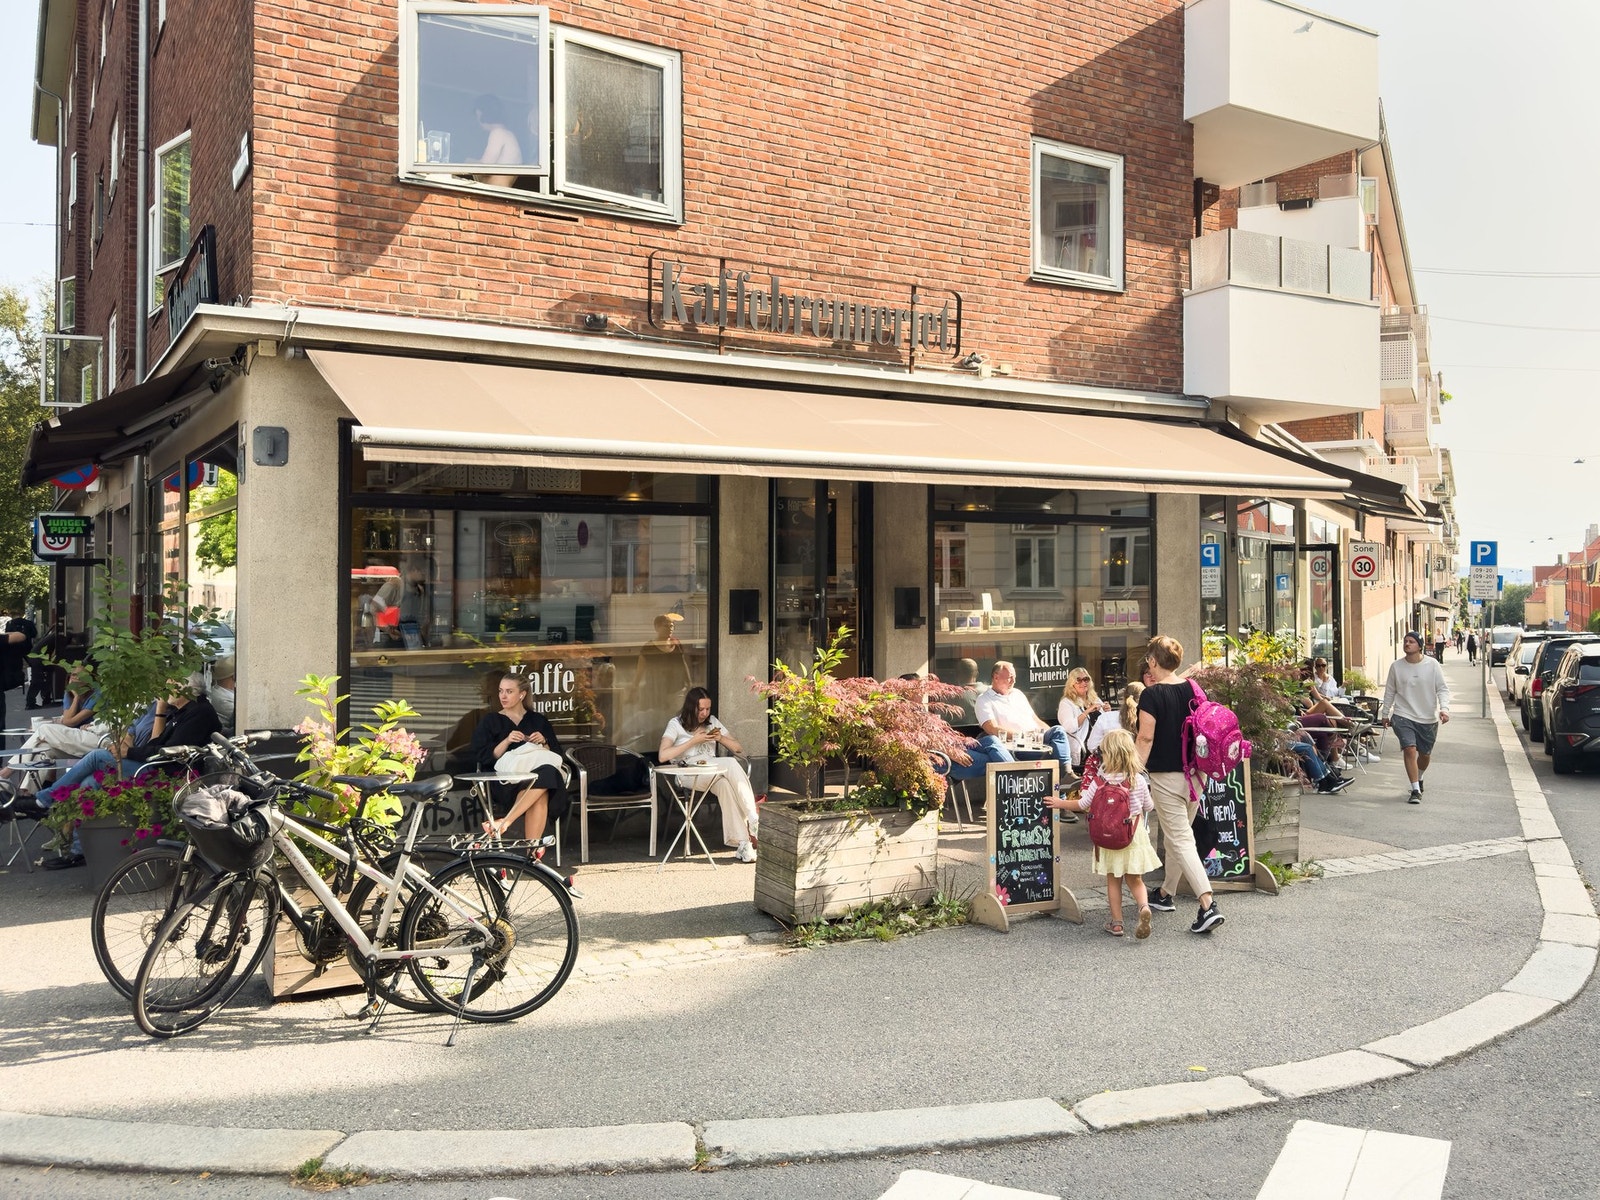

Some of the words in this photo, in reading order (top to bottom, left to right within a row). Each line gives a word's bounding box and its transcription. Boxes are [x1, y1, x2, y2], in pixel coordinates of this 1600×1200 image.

[661, 261, 953, 352] Kaffebrenneriet
[1476, 543, 1492, 563] P
[1356, 561, 1371, 573] 30
[1029, 642, 1070, 668] Kaffe
[509, 662, 575, 695] affe
[997, 774, 1045, 794] MÅNEDENS
[1009, 797, 1031, 816] KAFFE
[1002, 825, 1051, 848] FRANSK
